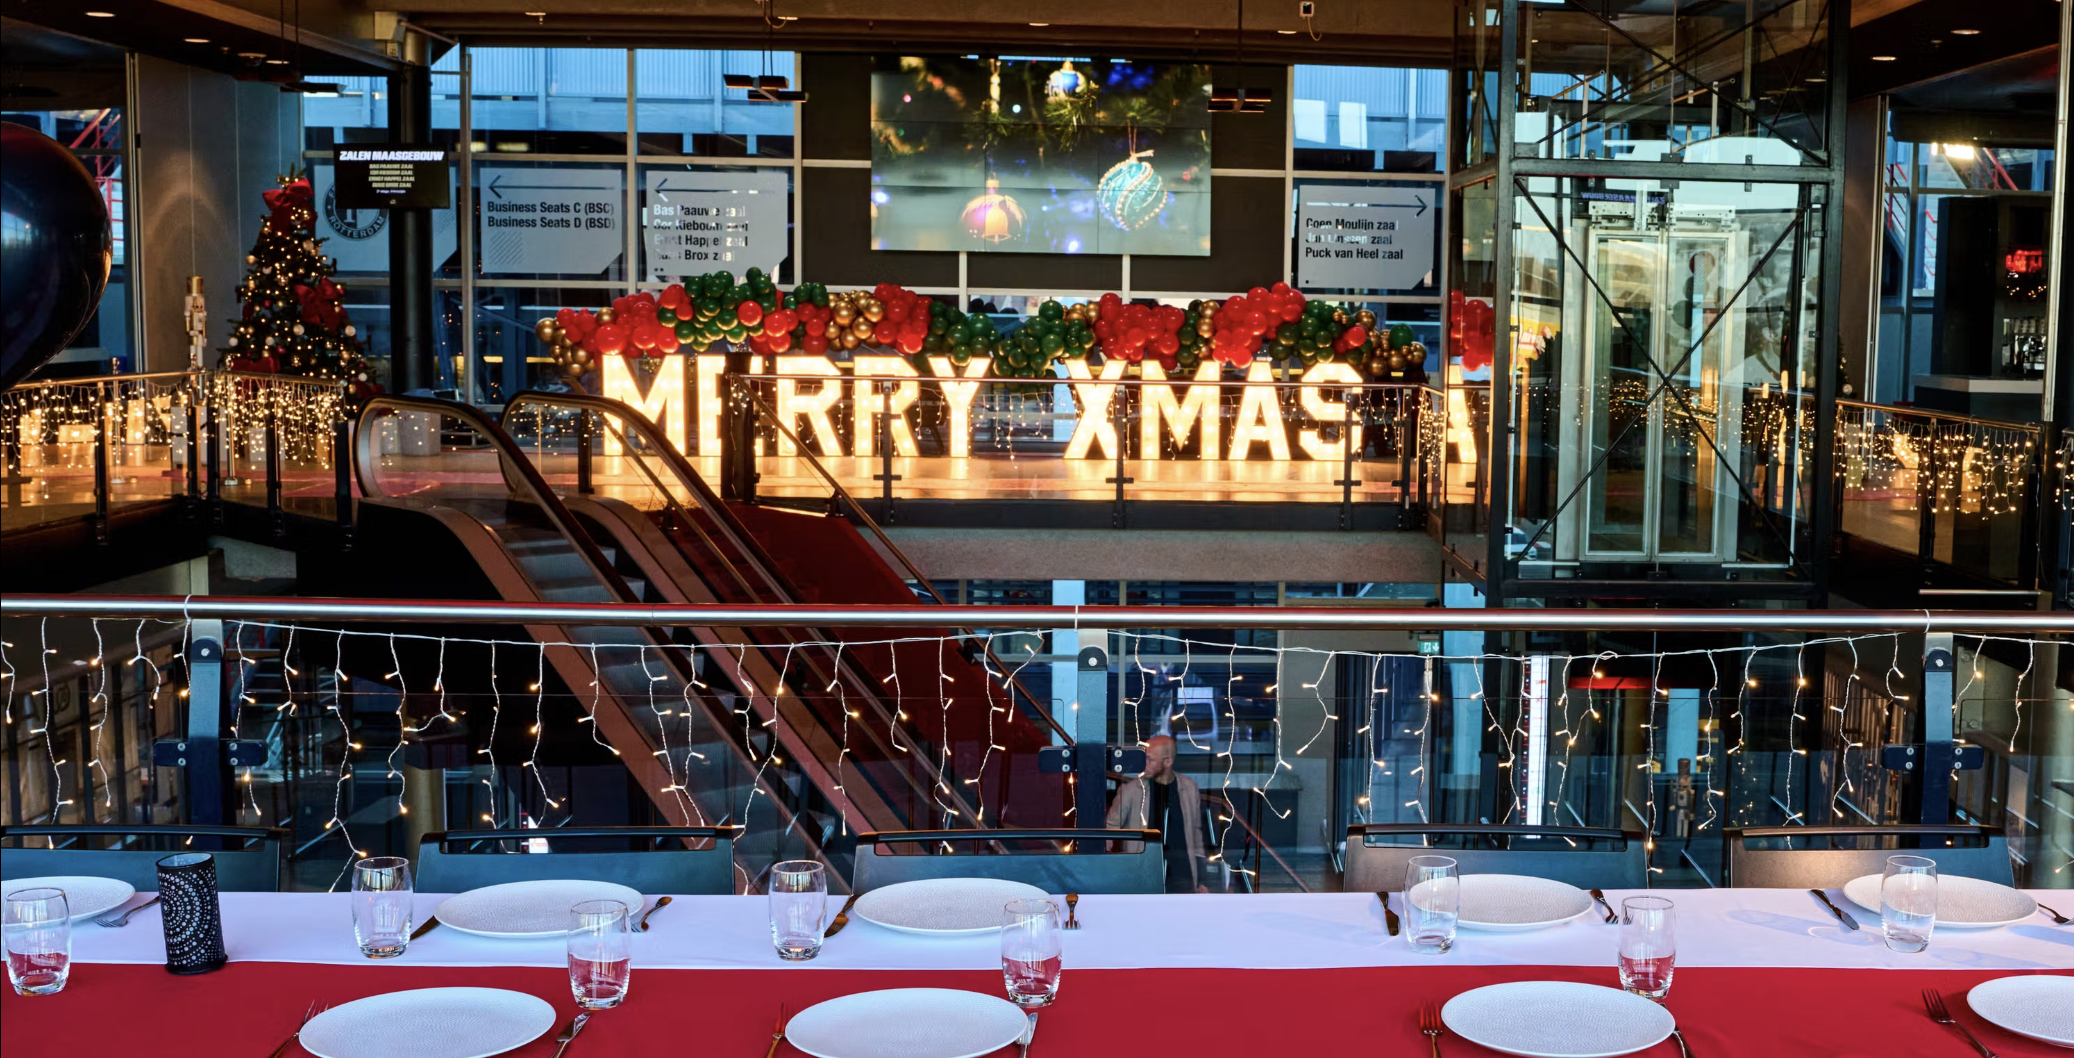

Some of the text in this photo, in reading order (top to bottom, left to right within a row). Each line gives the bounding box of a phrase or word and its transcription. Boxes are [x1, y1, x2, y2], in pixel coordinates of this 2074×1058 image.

[339, 151, 445, 161] ZALEN MAASGEBOUW
[487, 201, 614, 216] Business Seats C (BSC)
[653, 204, 674, 216] Bas
[328, 215, 385, 239] ROTTERDAM
[487, 216, 615, 231] Business Seats D (BSD)
[653, 219, 673, 230] Cor
[1335, 218, 1374, 232] Moulijn
[1376, 219, 1399, 231] zaal
[1371, 234, 1392, 245] zaal
[684, 249, 709, 261] Brox
[1305, 247, 1404, 260] Puck van Heel zaal
[602, 354, 992, 457] MERRY
[1063, 359, 1364, 461] XMAS
